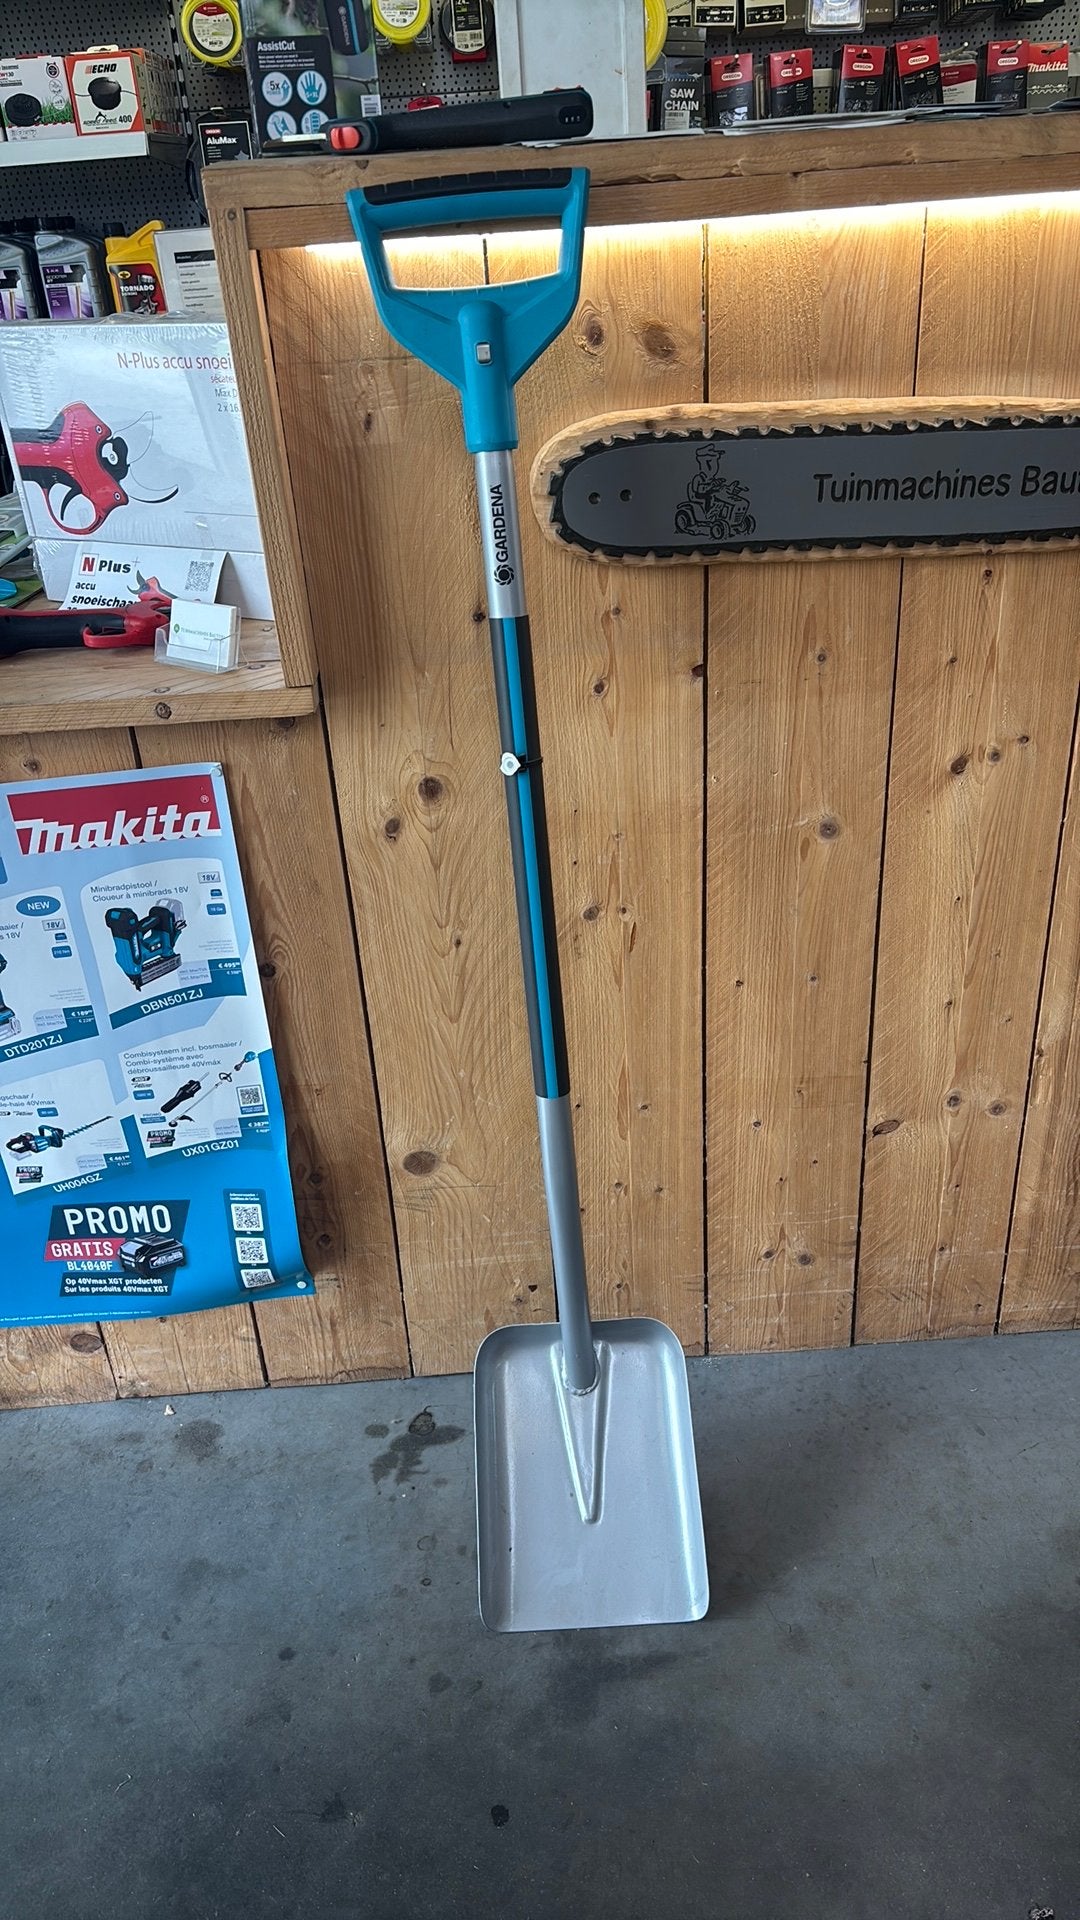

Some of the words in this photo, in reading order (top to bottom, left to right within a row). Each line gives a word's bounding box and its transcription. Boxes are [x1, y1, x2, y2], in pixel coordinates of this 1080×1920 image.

[257, 41, 296, 51] AssistCut
[908, 56, 929, 64] OREGON
[92, 63, 117, 74] ECHO
[269, 80, 280, 91] 5x
[670, 88, 695, 98] SAW
[664, 100, 699, 110] CHAIN
[119, 115, 133, 123] 400
[206, 136, 237, 145] AluMax
[120, 284, 155, 292] TORNADO
[117, 352, 160, 369] N-Plus
[163, 355, 192, 369] accu
[215, 388, 231, 398] Max
[217, 403, 223, 413] 2
[813, 468, 1011, 503] Tuinmachines
[1021, 465, 1080, 497] Bau
[490, 483, 509, 563] GARDENA
[82, 556, 96, 572] N
[98, 560, 132, 574] Plus
[75, 582, 97, 591] accu
[90, 880, 153, 893] Minibradpistool
[92, 893, 124, 903] Cloueur
[133, 888, 173, 899] minibrads
[174, 885, 189, 894] 18V
[27, 901, 50, 911] NEW
[46, 921, 60, 929] 18V
[6, 931, 21, 940] 18V
[140, 988, 204, 1014] DBN501ZJ
[3, 1033, 64, 1058] DTD201ZJ
[123, 1047, 180, 1060] Combisysteem
[198, 1041, 238, 1051] bosmaaier
[125, 1054, 185, 1068] Combi-système
[186, 1053, 204, 1061] avec
[127, 1062, 191, 1075] débroussailleuse
[182, 1139, 240, 1157] UX01GZ01
[53, 1173, 103, 1193] UH004GZ
[63, 1204, 172, 1235] PROMO
[51, 1241, 114, 1258] GRATIS
[125, 1277, 163, 1286] producten
[78, 1285, 90, 1293] les
[91, 1285, 122, 1294] produits
[122, 1285, 152, 1293] 40Vmax
[153, 1285, 169, 1293] XGT
